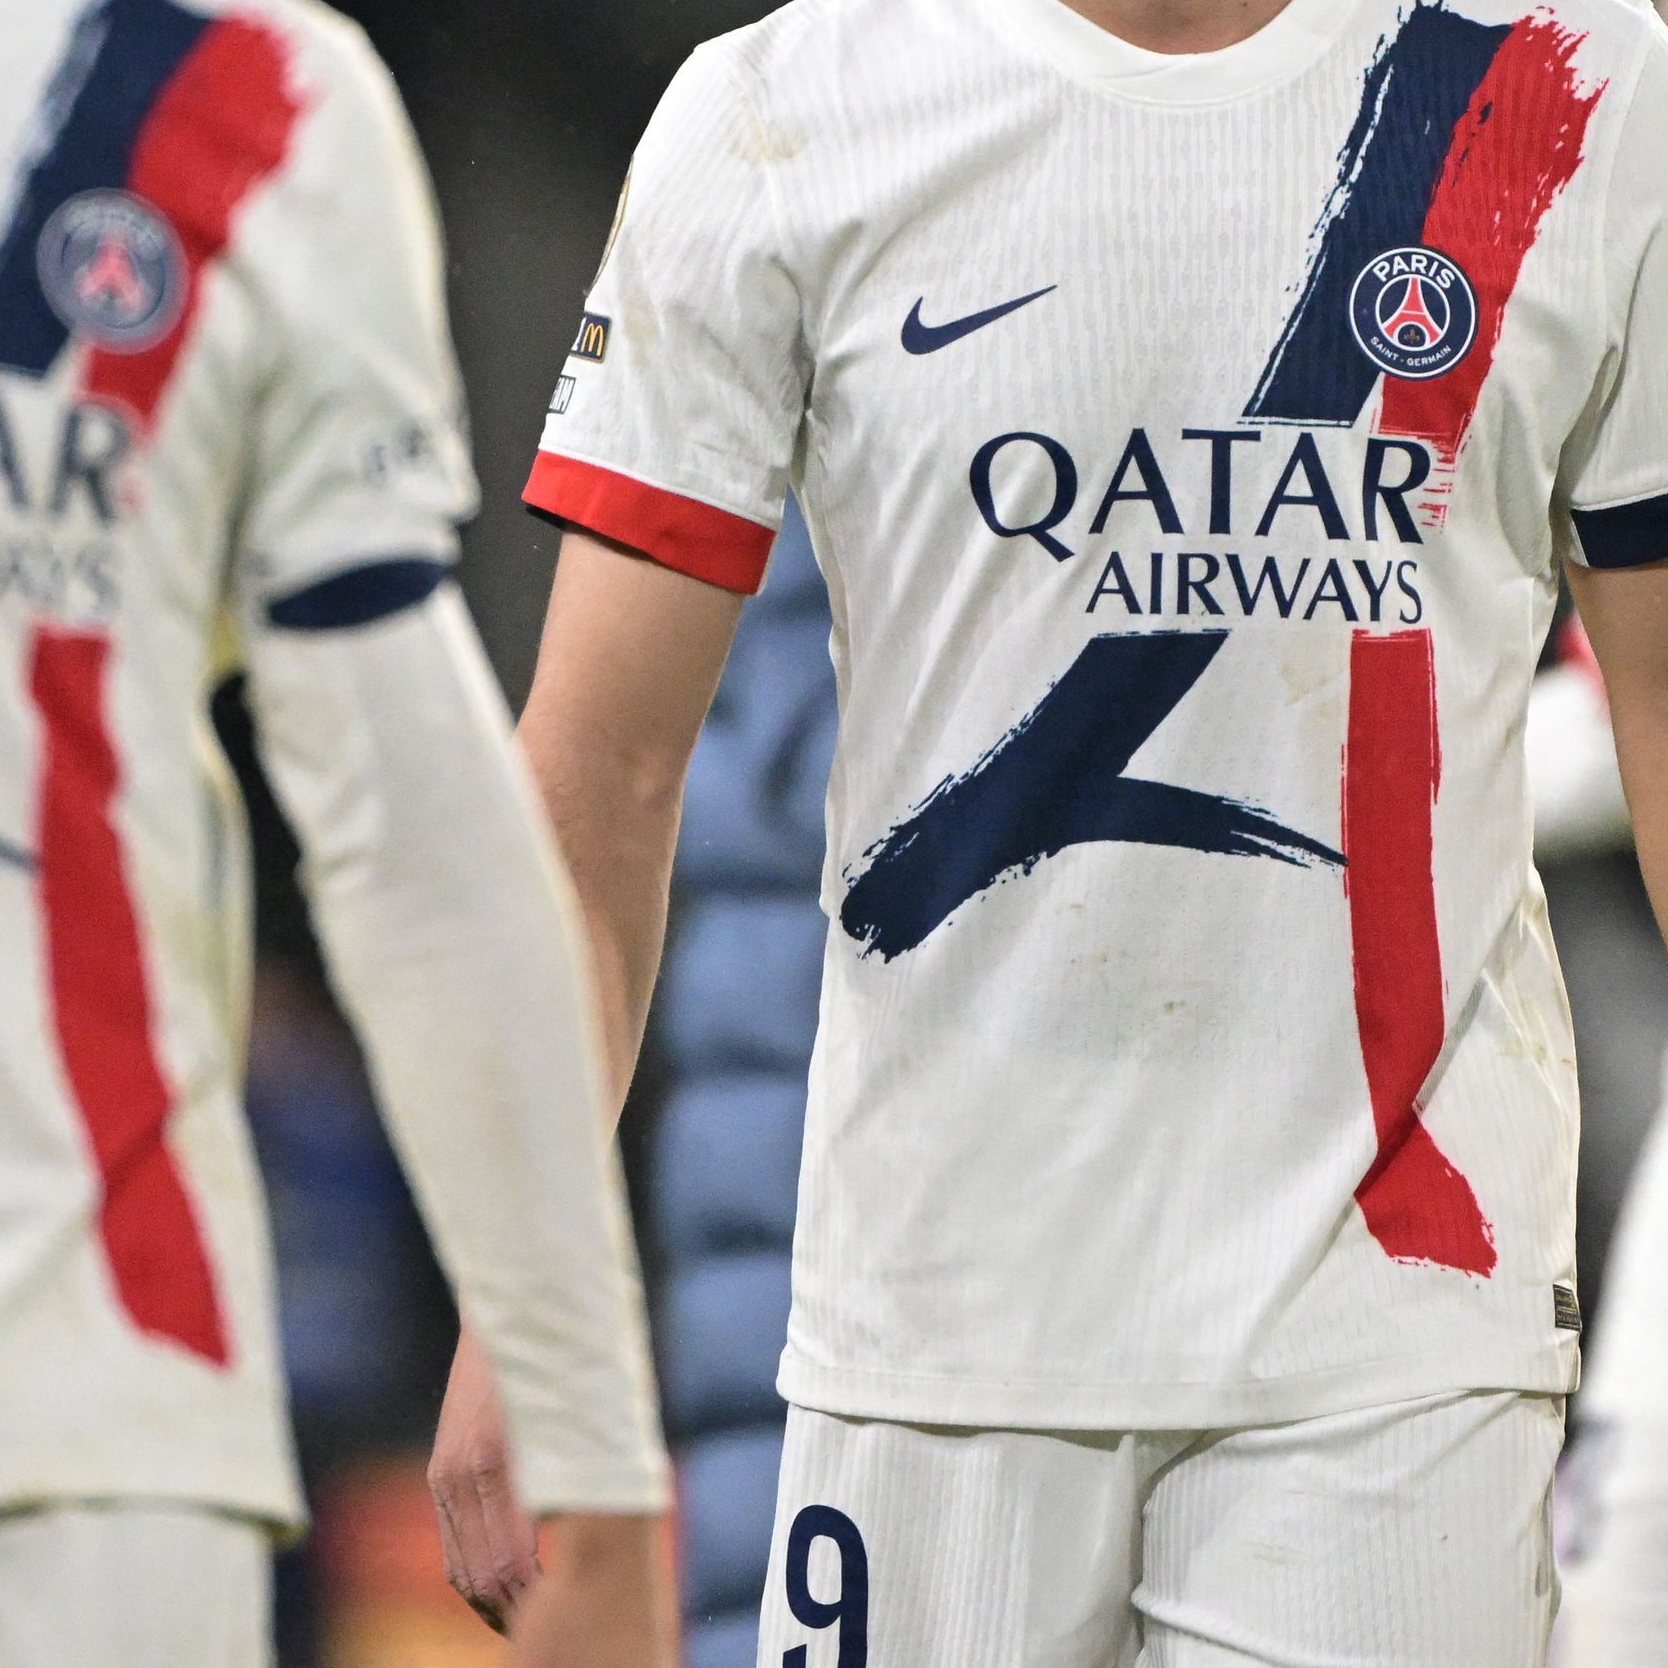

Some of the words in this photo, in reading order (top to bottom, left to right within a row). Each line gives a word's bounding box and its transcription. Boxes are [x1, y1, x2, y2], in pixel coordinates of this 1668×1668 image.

[1372, 254, 1455, 289] PARIS
[969, 427, 1431, 562] QATAR
[1085, 551, 1423, 624] AIRWAYS
[785, 1504, 869, 1668] 9
